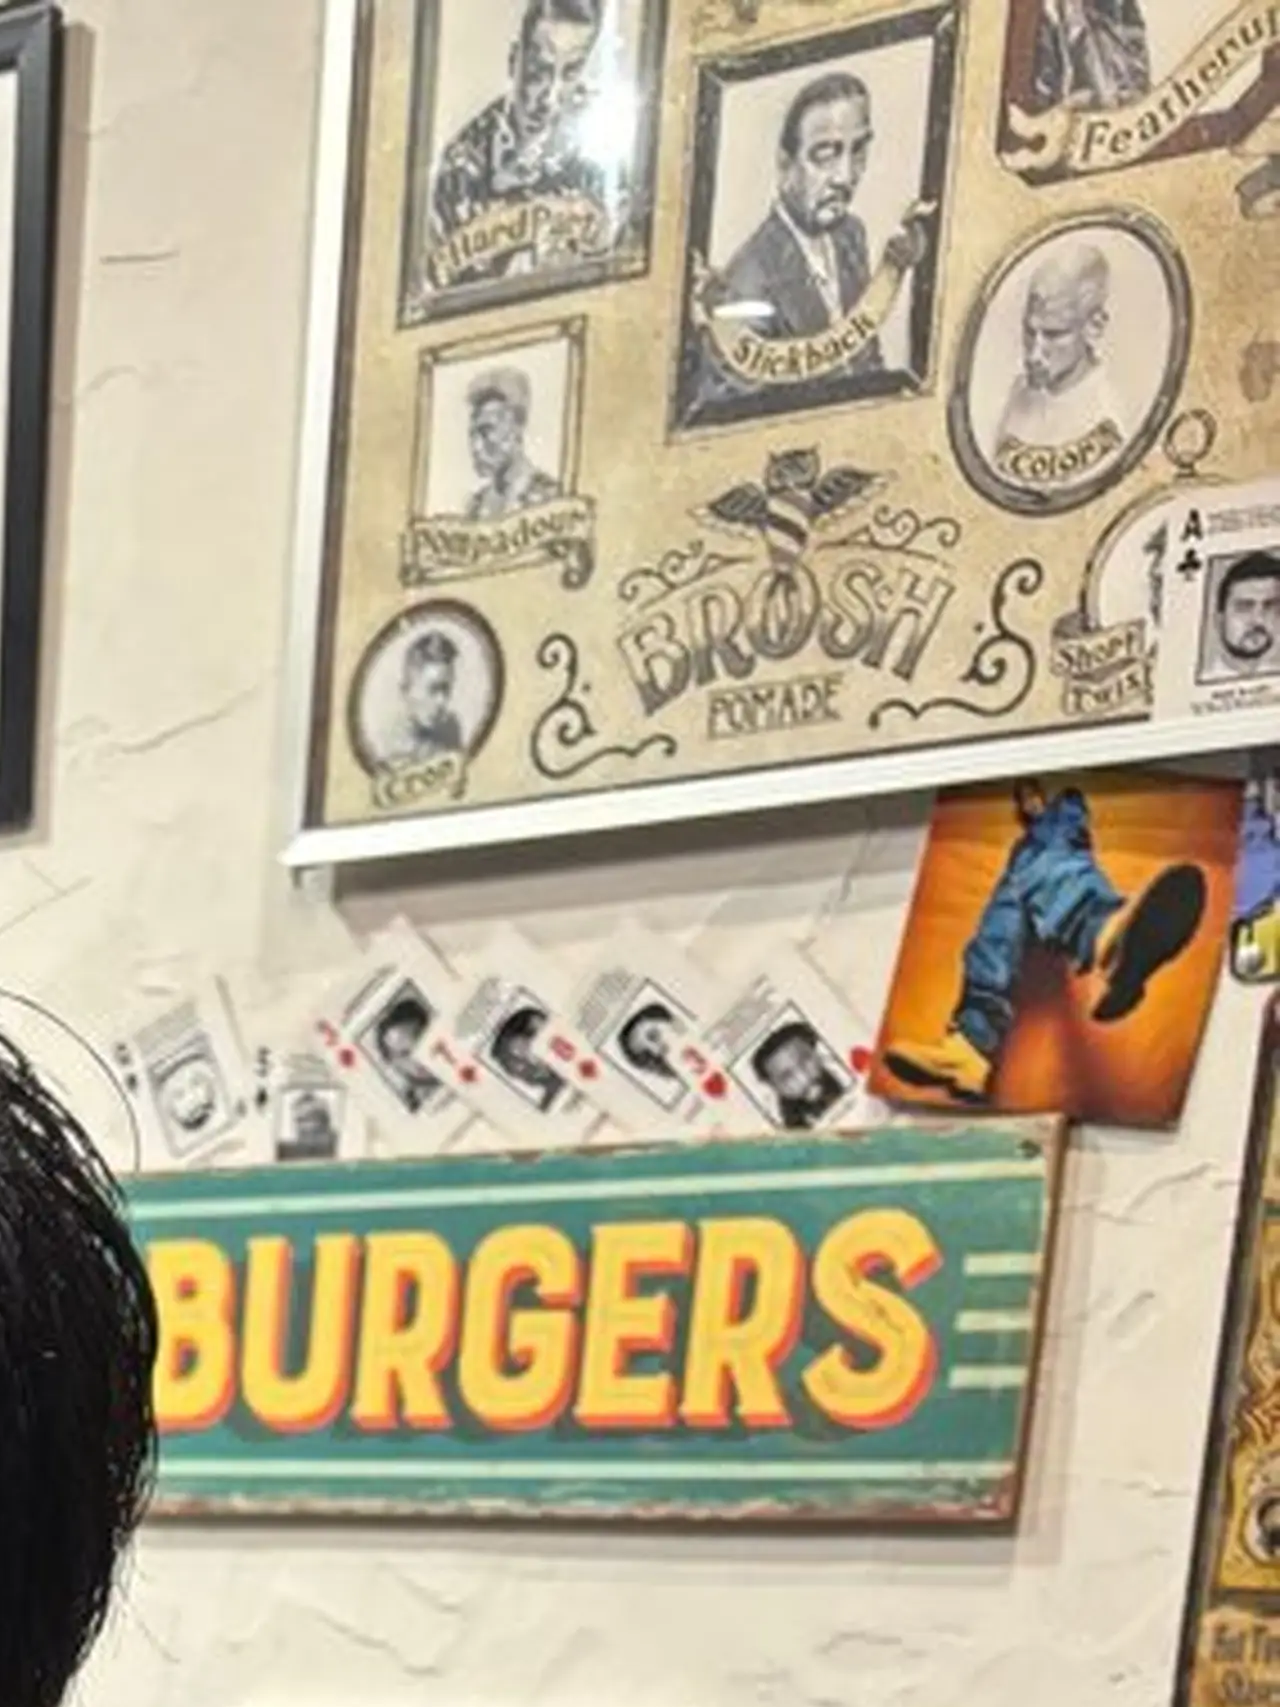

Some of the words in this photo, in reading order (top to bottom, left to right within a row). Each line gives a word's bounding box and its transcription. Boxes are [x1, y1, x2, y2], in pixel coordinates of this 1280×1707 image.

[1178, 507, 1204, 541] A
[617, 560, 956, 716] BROSH
[706, 672, 844, 739] POMADE
[144, 1206, 945, 1433] BURGERS
